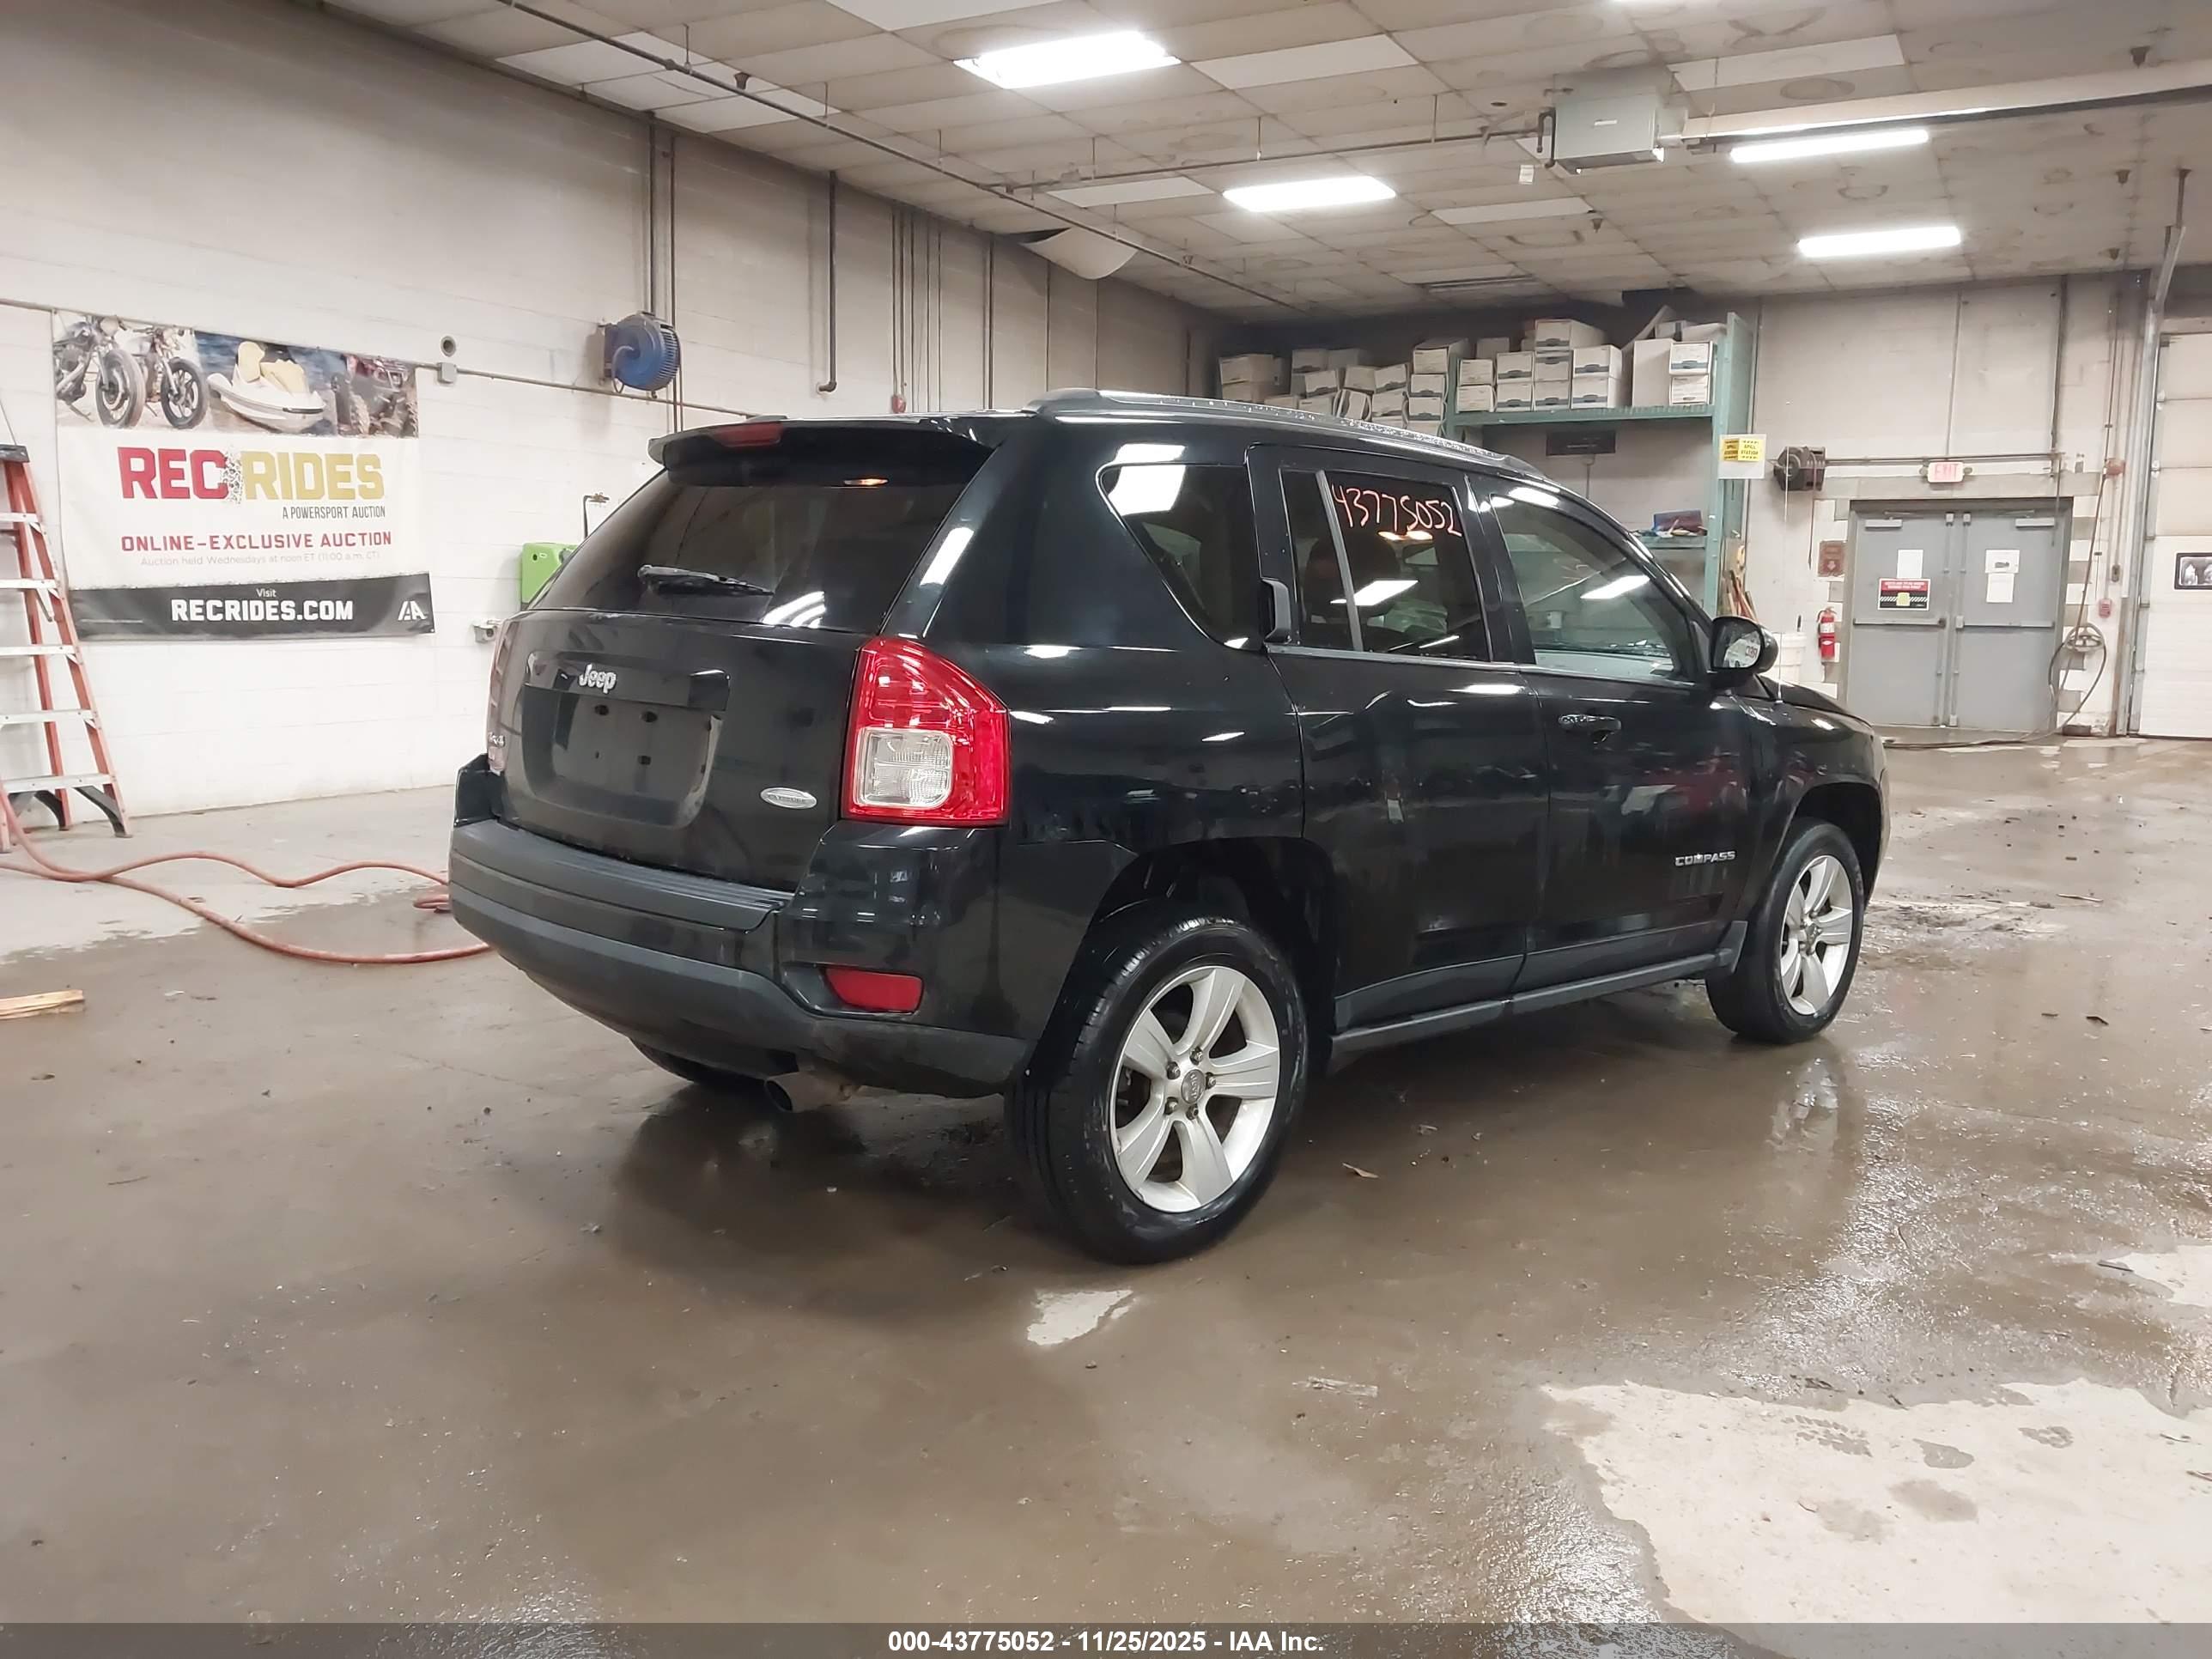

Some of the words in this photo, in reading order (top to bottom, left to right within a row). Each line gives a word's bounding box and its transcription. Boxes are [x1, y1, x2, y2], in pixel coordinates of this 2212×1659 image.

[118, 447, 228, 499] REC
[240, 451, 385, 501] RIDES
[283, 506, 289, 520] A
[290, 506, 349, 519] POWERSPORT
[352, 505, 386, 519] AUCTION
[1332, 484, 1462, 537] 43775052
[121, 533, 313, 552] ONLINE-EXCLUSIVE
[320, 531, 392, 548] AUCTION
[141, 556, 179, 567] Auction
[181, 555, 204, 566] held
[207, 554, 266, 565] Wednesdays
[269, 554, 278, 563] at
[280, 555, 302, 563] noon
[304, 552, 315, 562] ET
[256, 587, 276, 598] Visit
[171, 599, 354, 622] RECRIDES.COM
[579, 663, 617, 694] Jeep
[1675, 850, 1735, 866] COMPASS
